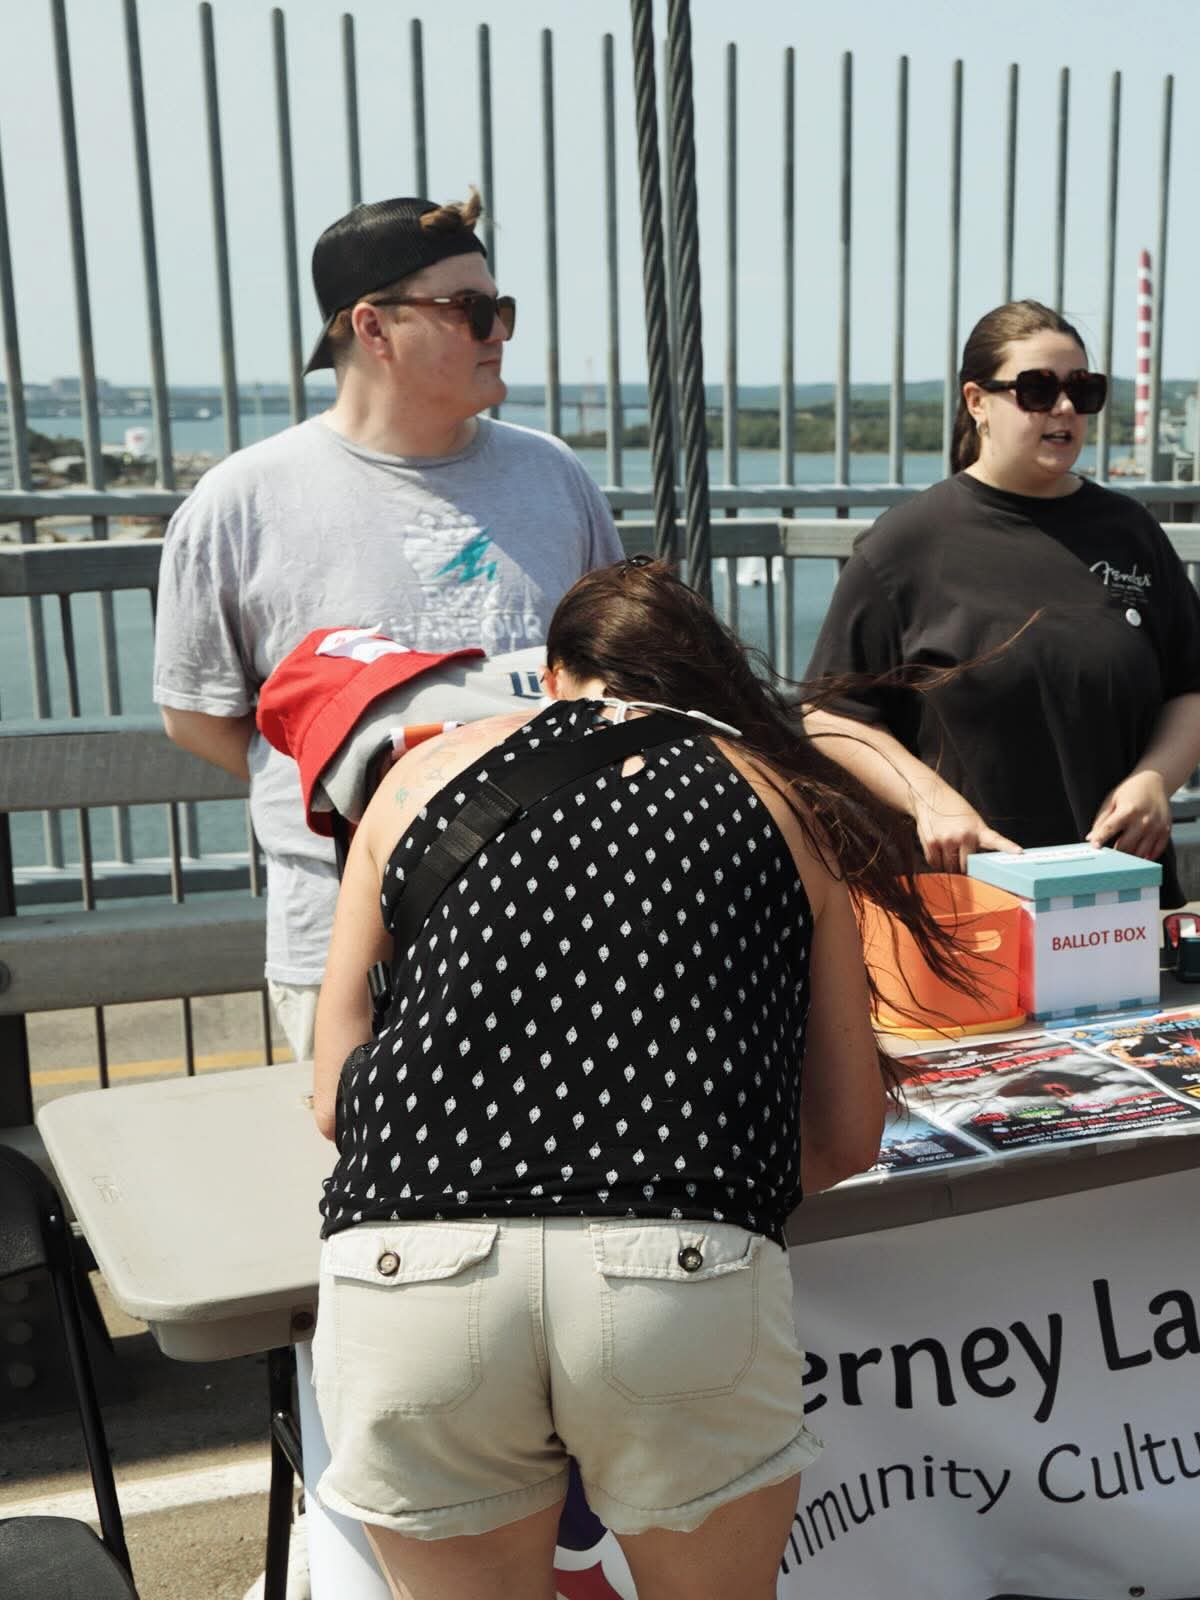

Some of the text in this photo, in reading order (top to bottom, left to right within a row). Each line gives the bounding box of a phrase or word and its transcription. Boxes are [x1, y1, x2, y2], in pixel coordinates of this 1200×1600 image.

[1089, 560, 1152, 586] Fender
[1052, 926, 1146, 951] BALLOT BOX
